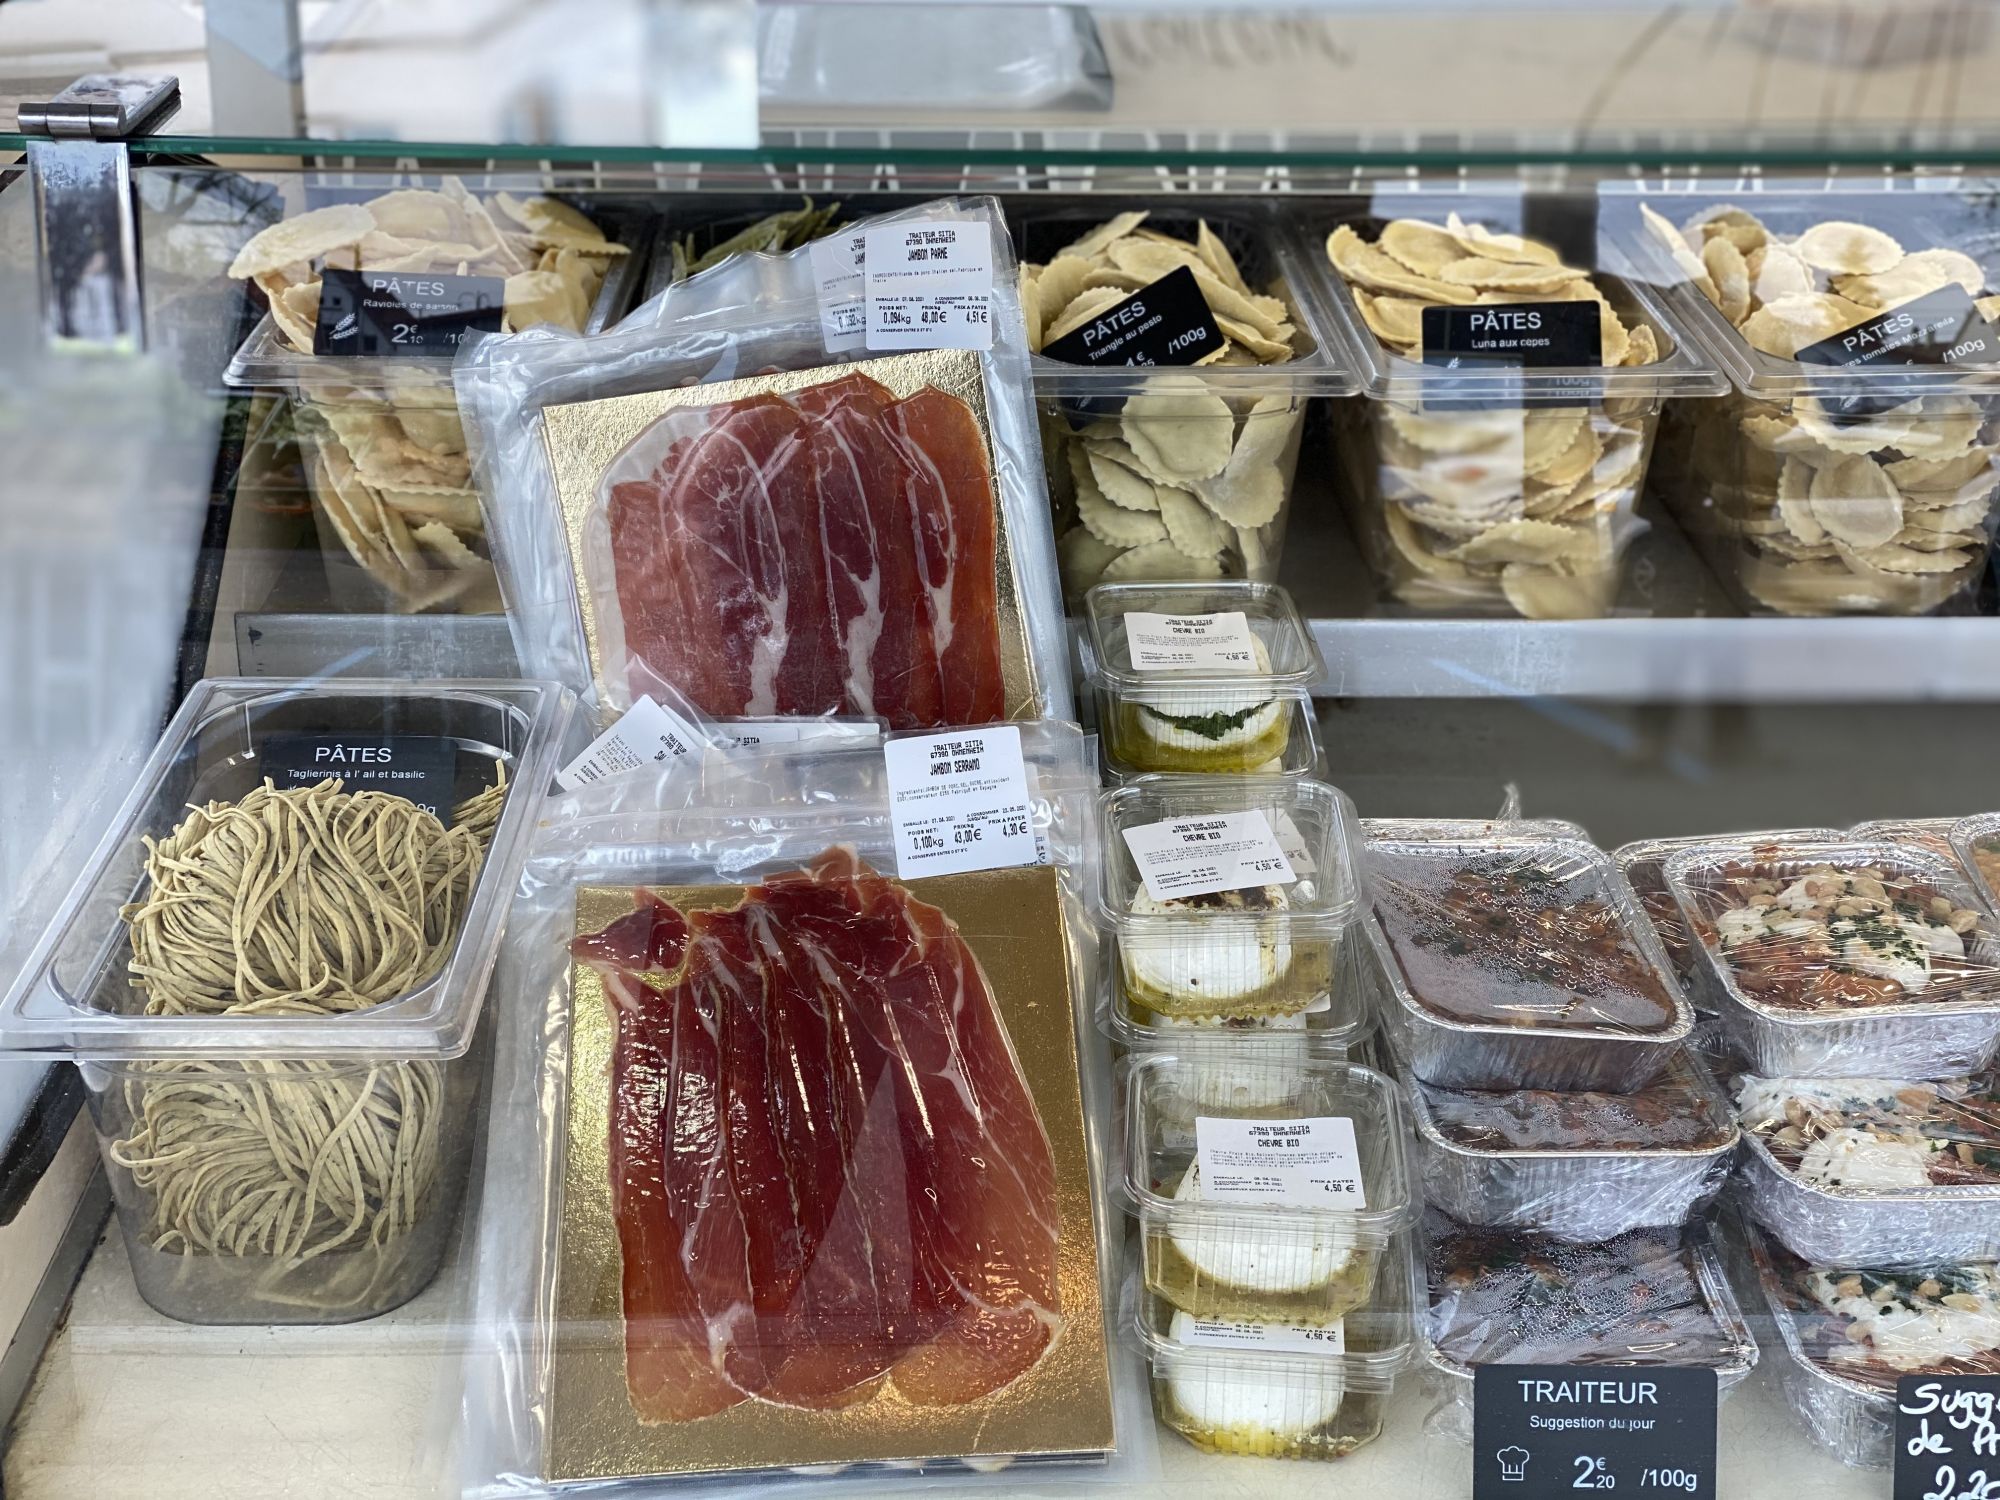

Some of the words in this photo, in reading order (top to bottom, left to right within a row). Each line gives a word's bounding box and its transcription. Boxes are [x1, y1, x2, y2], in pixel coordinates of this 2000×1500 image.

[908, 231, 936, 239] TRAITEUR
[938, 230, 956, 238] SITIA
[851, 244, 866, 252] 6739
[908, 248, 928, 262] JAMBON
[930, 247, 948, 260] PARME
[372, 276, 444, 296] PÂTES
[410, 302, 422, 310] de
[883, 312, 912, 325] 0,094kg
[1082, 301, 1146, 346] PÂTES
[1470, 310, 1542, 331] PÂTES
[443, 332, 466, 344] /10
[1088, 336, 1124, 361] Triangle
[1124, 330, 1138, 340] au
[1138, 314, 1162, 334] pesto
[1842, 312, 1914, 352] PÂTES
[1862, 340, 1900, 361] tomates
[1902, 315, 1955, 344] Mozzarella
[1168, 326, 1207, 355] /100g
[1472, 340, 1496, 348] Luna
[1499, 340, 1518, 348] aux
[1942, 338, 1986, 364] /100g
[315, 744, 392, 763] PÂTES
[933, 742, 962, 752] TRAITEUR
[964, 740, 984, 749] SITIA
[930, 750, 949, 759] 67390
[930, 760, 952, 776] JAMBON
[954, 758, 980, 774] SERRANO
[288, 770, 340, 780] Taglierinis
[363, 770, 374, 778] ail
[392, 770, 425, 779] basilic
[902, 820, 922, 828] EMBALLE
[1007, 814, 1026, 822] PAYER
[914, 835, 944, 850] 0,100kg
[954, 828, 982, 844] 43,00€
[1002, 822, 1028, 838] 4,30€
[1182, 834, 1206, 842] CHEVRE
[1208, 832, 1222, 840] BIO
[1255, 864, 1271, 872] 4,50
[1274, 862, 1284, 870] €
[1258, 1139, 1283, 1148] CHEVRE
[1286, 1138, 1300, 1147] BIO
[1324, 1184, 1342, 1192] 4,50
[1346, 1184, 1355, 1192] €
[1305, 1332, 1323, 1340] 4,50
[1518, 1380, 1658, 1404] TRAITEUR
[1899, 1383, 2000, 1430] Sugg
[1530, 1415, 1604, 1431] Suggestion
[1608, 1418, 1625, 1429] du
[1628, 1418, 1656, 1432] jour
[1908, 1418, 1953, 1456] de
[1640, 1469, 1698, 1492] /100g
